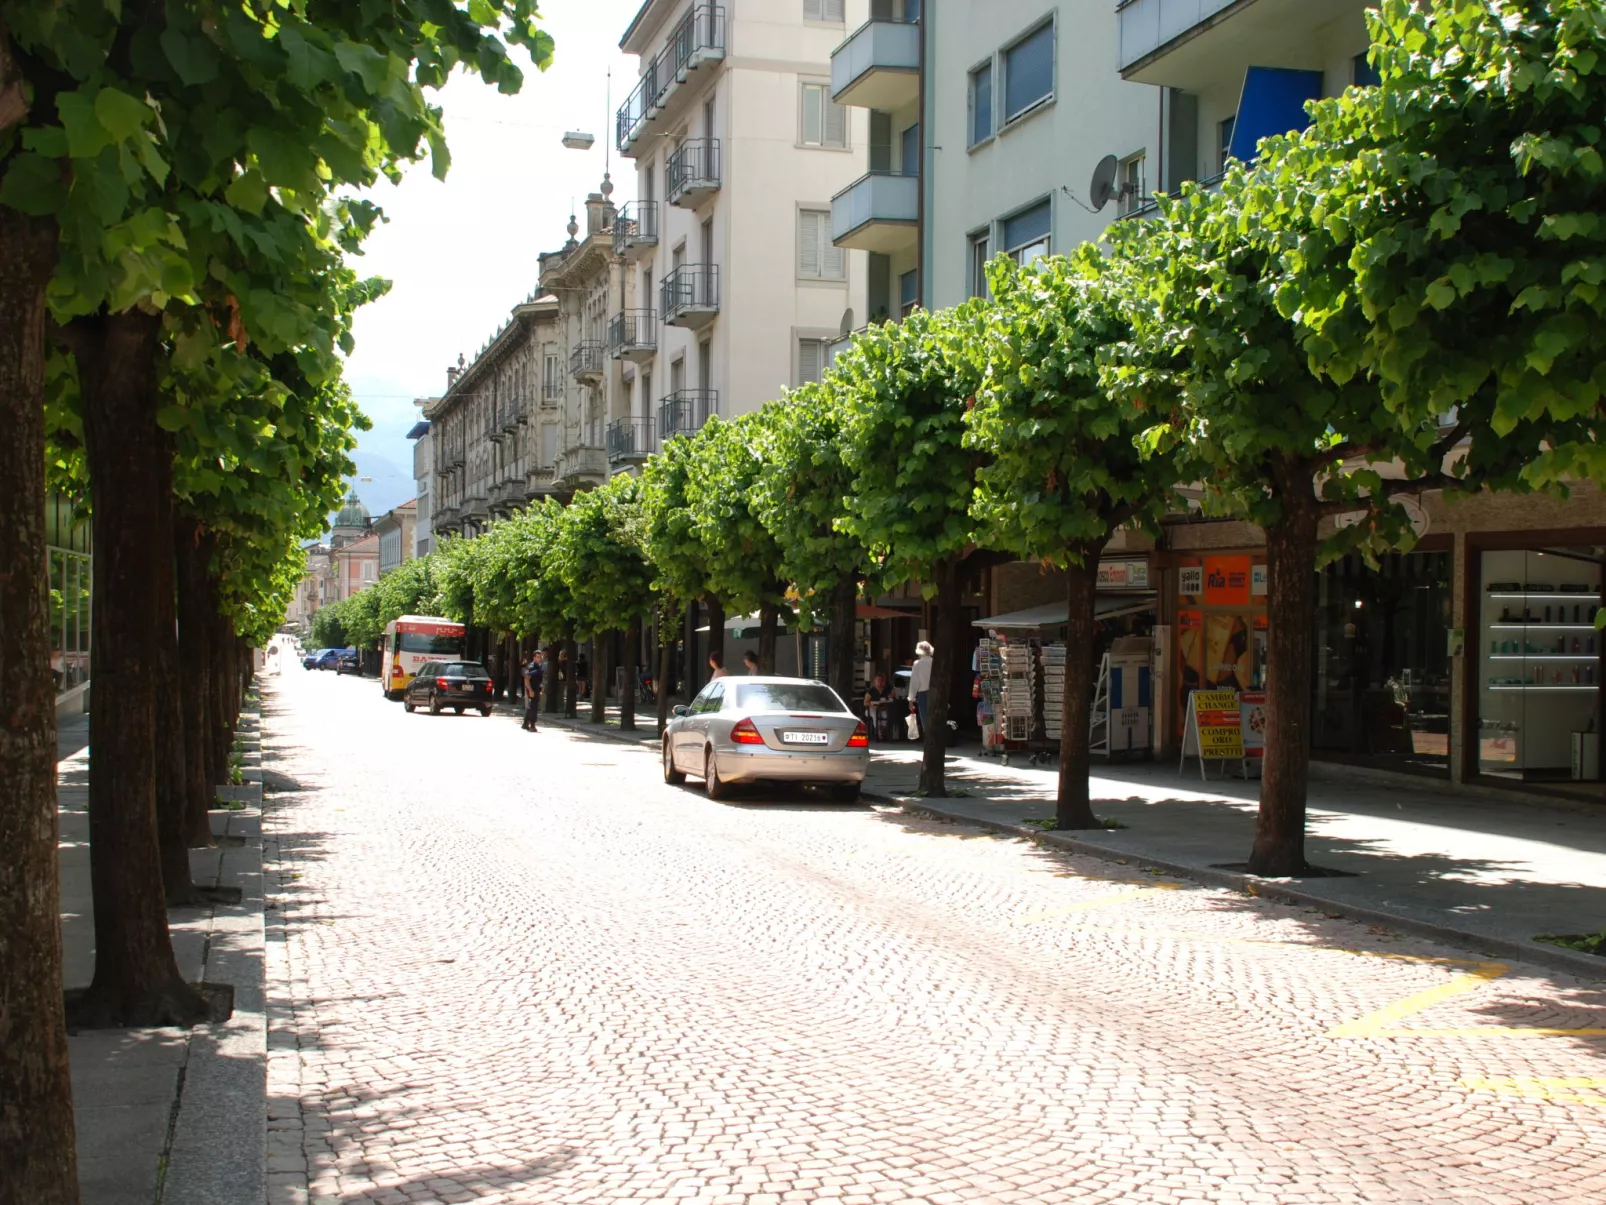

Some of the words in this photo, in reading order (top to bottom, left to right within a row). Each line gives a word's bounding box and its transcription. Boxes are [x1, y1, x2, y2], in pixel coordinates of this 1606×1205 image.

[1181, 571, 1200, 582] yallo
[1208, 568, 1225, 588] Ria
[1197, 694, 1235, 702] CAMBIO
[1201, 728, 1240, 736] COMPRO
[1203, 747, 1243, 756] PRESTITI
